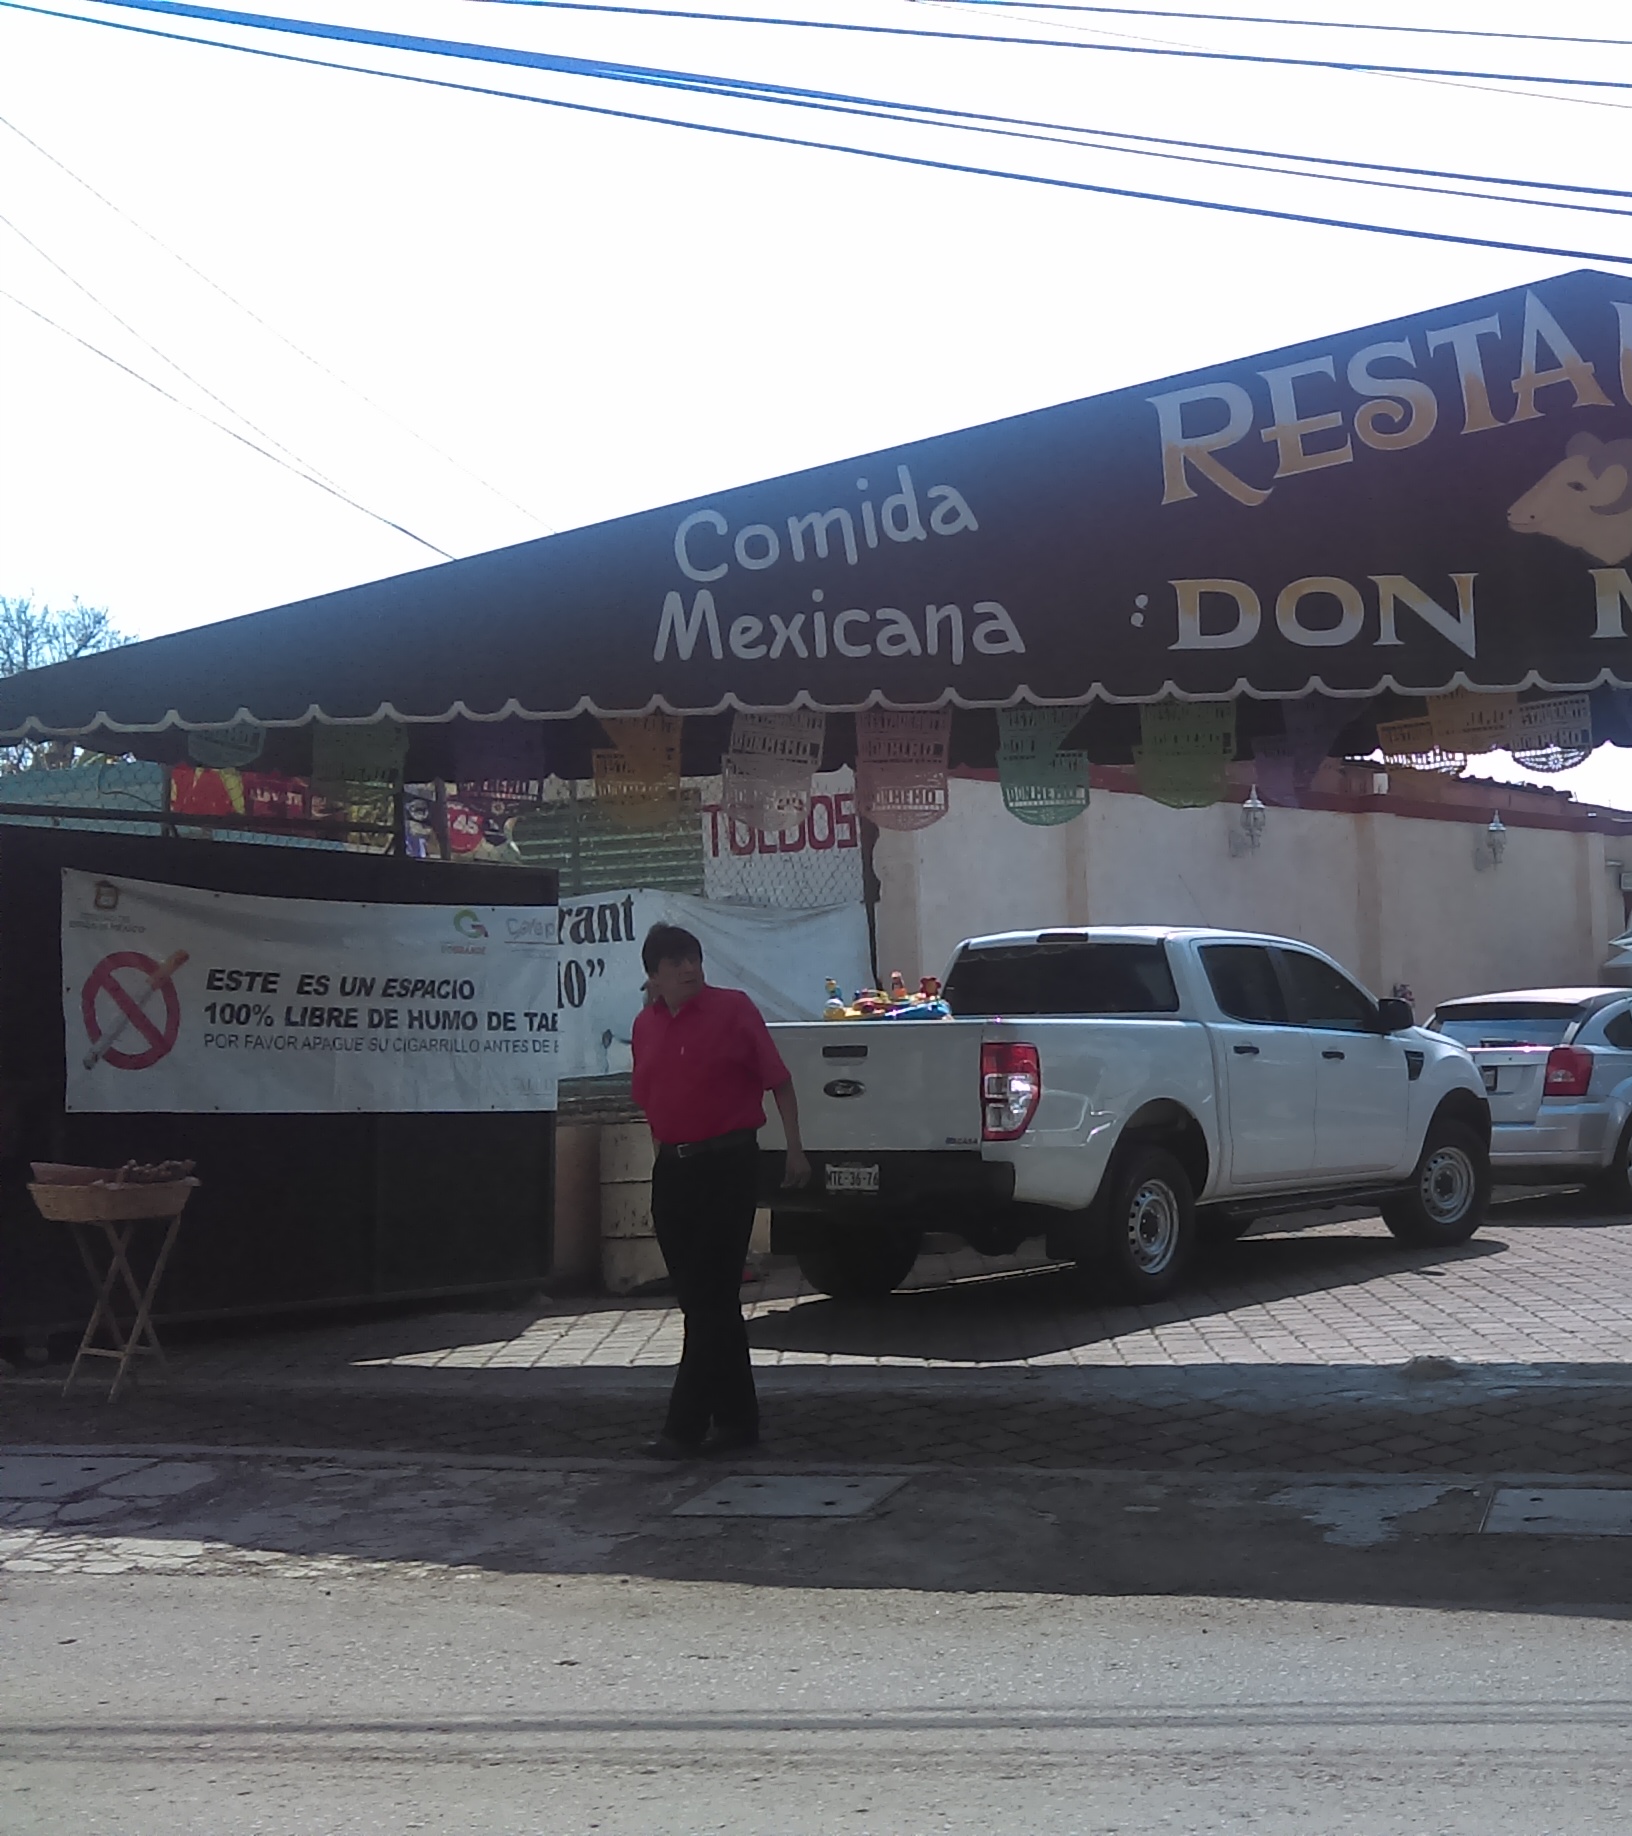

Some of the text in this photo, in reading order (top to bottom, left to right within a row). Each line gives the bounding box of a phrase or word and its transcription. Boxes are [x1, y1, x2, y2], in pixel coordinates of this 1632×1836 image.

[674, 465, 979, 582] Comida
[654, 588, 1026, 665] Mexicana
[206, 969, 475, 1000] ESTE ES UN ESPACIO
[204, 1002, 274, 1027] 100%
[285, 1006, 359, 1028] LIBRE
[368, 1008, 399, 1029] DE
[408, 1009, 478, 1032] HUMO
[488, 1011, 517, 1032] DE
[204, 1034, 239, 1049] POR
[244, 1034, 298, 1050] FAVOR
[302, 1036, 364, 1051] APAGUE
[368, 1037, 388, 1052] SU
[393, 1038, 480, 1053] CIGARRILLO
[484, 1039, 529, 1053] ANTES
[532, 1040, 550, 1053] DE
